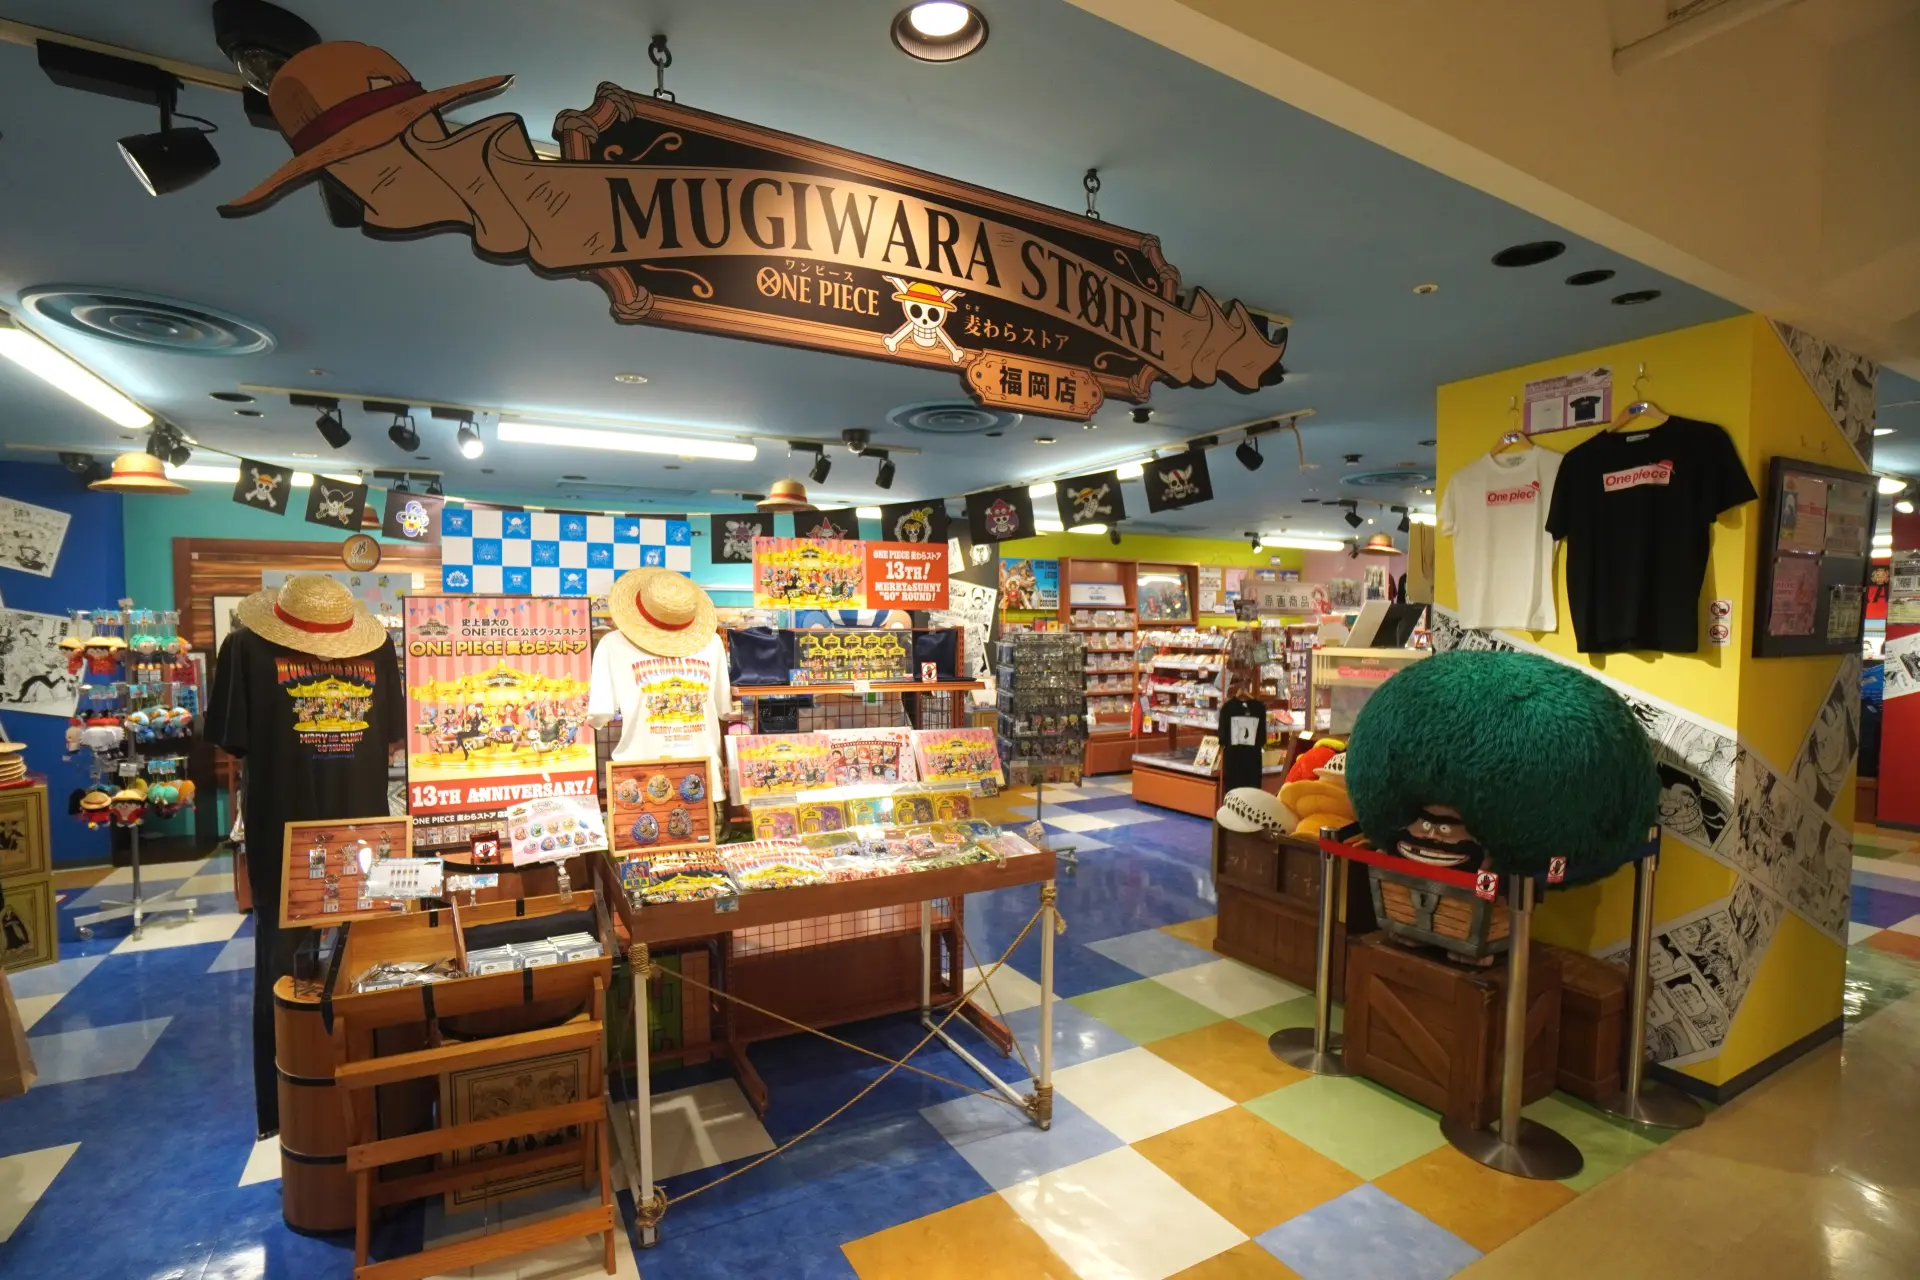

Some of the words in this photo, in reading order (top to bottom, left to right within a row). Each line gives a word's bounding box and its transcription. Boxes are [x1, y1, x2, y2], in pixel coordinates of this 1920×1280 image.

[606, 177, 1002, 289] MUGIWARA
[1021, 240, 1165, 362] STORE
[785, 259, 854, 282] ワンピース
[756, 266, 812, 304] ONE
[818, 279, 880, 316] PIECE
[964, 314, 1070, 352] 麦わらストア
[999, 365, 1077, 405] 福岡店
[1605, 473, 1631, 486] One
[1632, 469, 1668, 484] piece
[1487, 492, 1508, 502] One
[873, 550, 889, 559] ONE
[889, 550, 910, 559] PIECE
[885, 561, 931, 580] 13TH!
[901, 591, 936, 602] ROUND!
[1265, 594, 1310, 608] 原画商品
[462, 618, 509, 627] 史上最大の
[461, 628, 487, 637] ONE
[490, 628, 519, 637] PIECE
[409, 640, 453, 657] ONE
[456, 640, 503, 657] PIECE
[506, 640, 588, 656] 麦わらストア
[412, 785, 462, 807] 13TH
[467, 776, 594, 804] ANNIVERSARY!
[412, 817, 430, 825] ONE
[432, 814, 455, 823] PIECE
[456, 811, 497, 821] 麦わらストア
